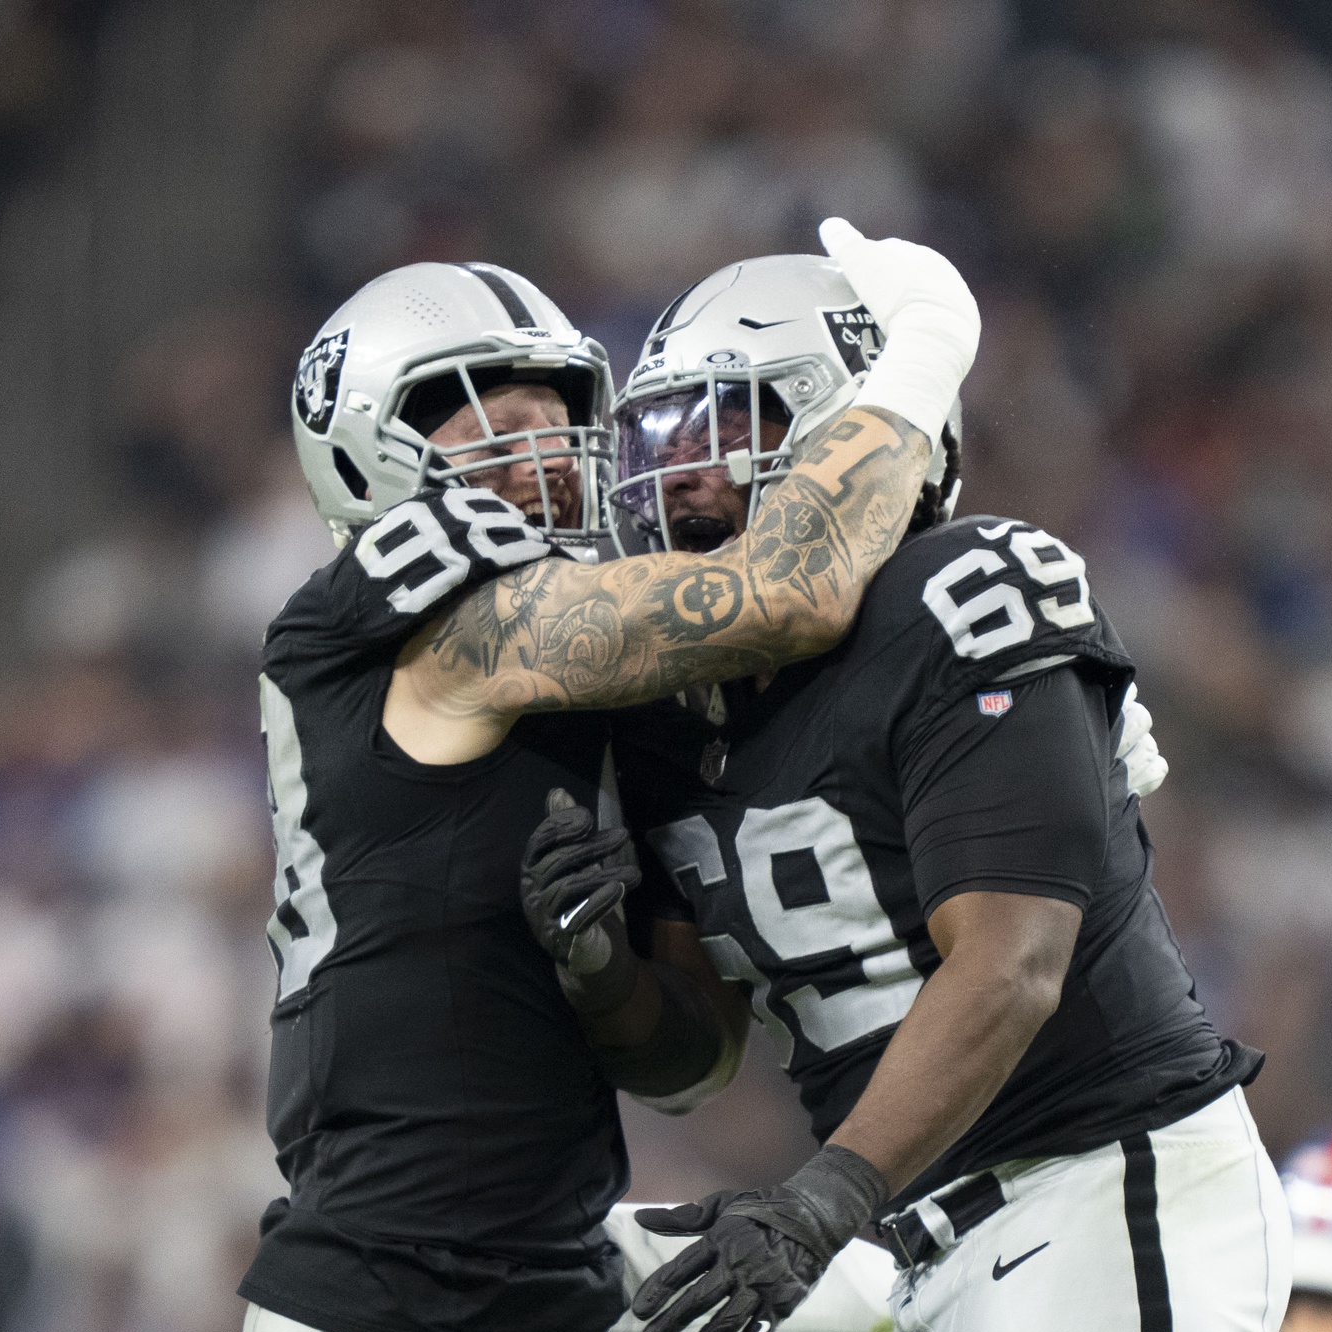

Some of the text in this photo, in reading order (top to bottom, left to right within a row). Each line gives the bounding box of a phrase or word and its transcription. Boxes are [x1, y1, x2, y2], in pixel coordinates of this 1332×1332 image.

[355, 488, 549, 614] 98
[922, 529, 1092, 659] 69
[982, 695, 1009, 712] NFL
